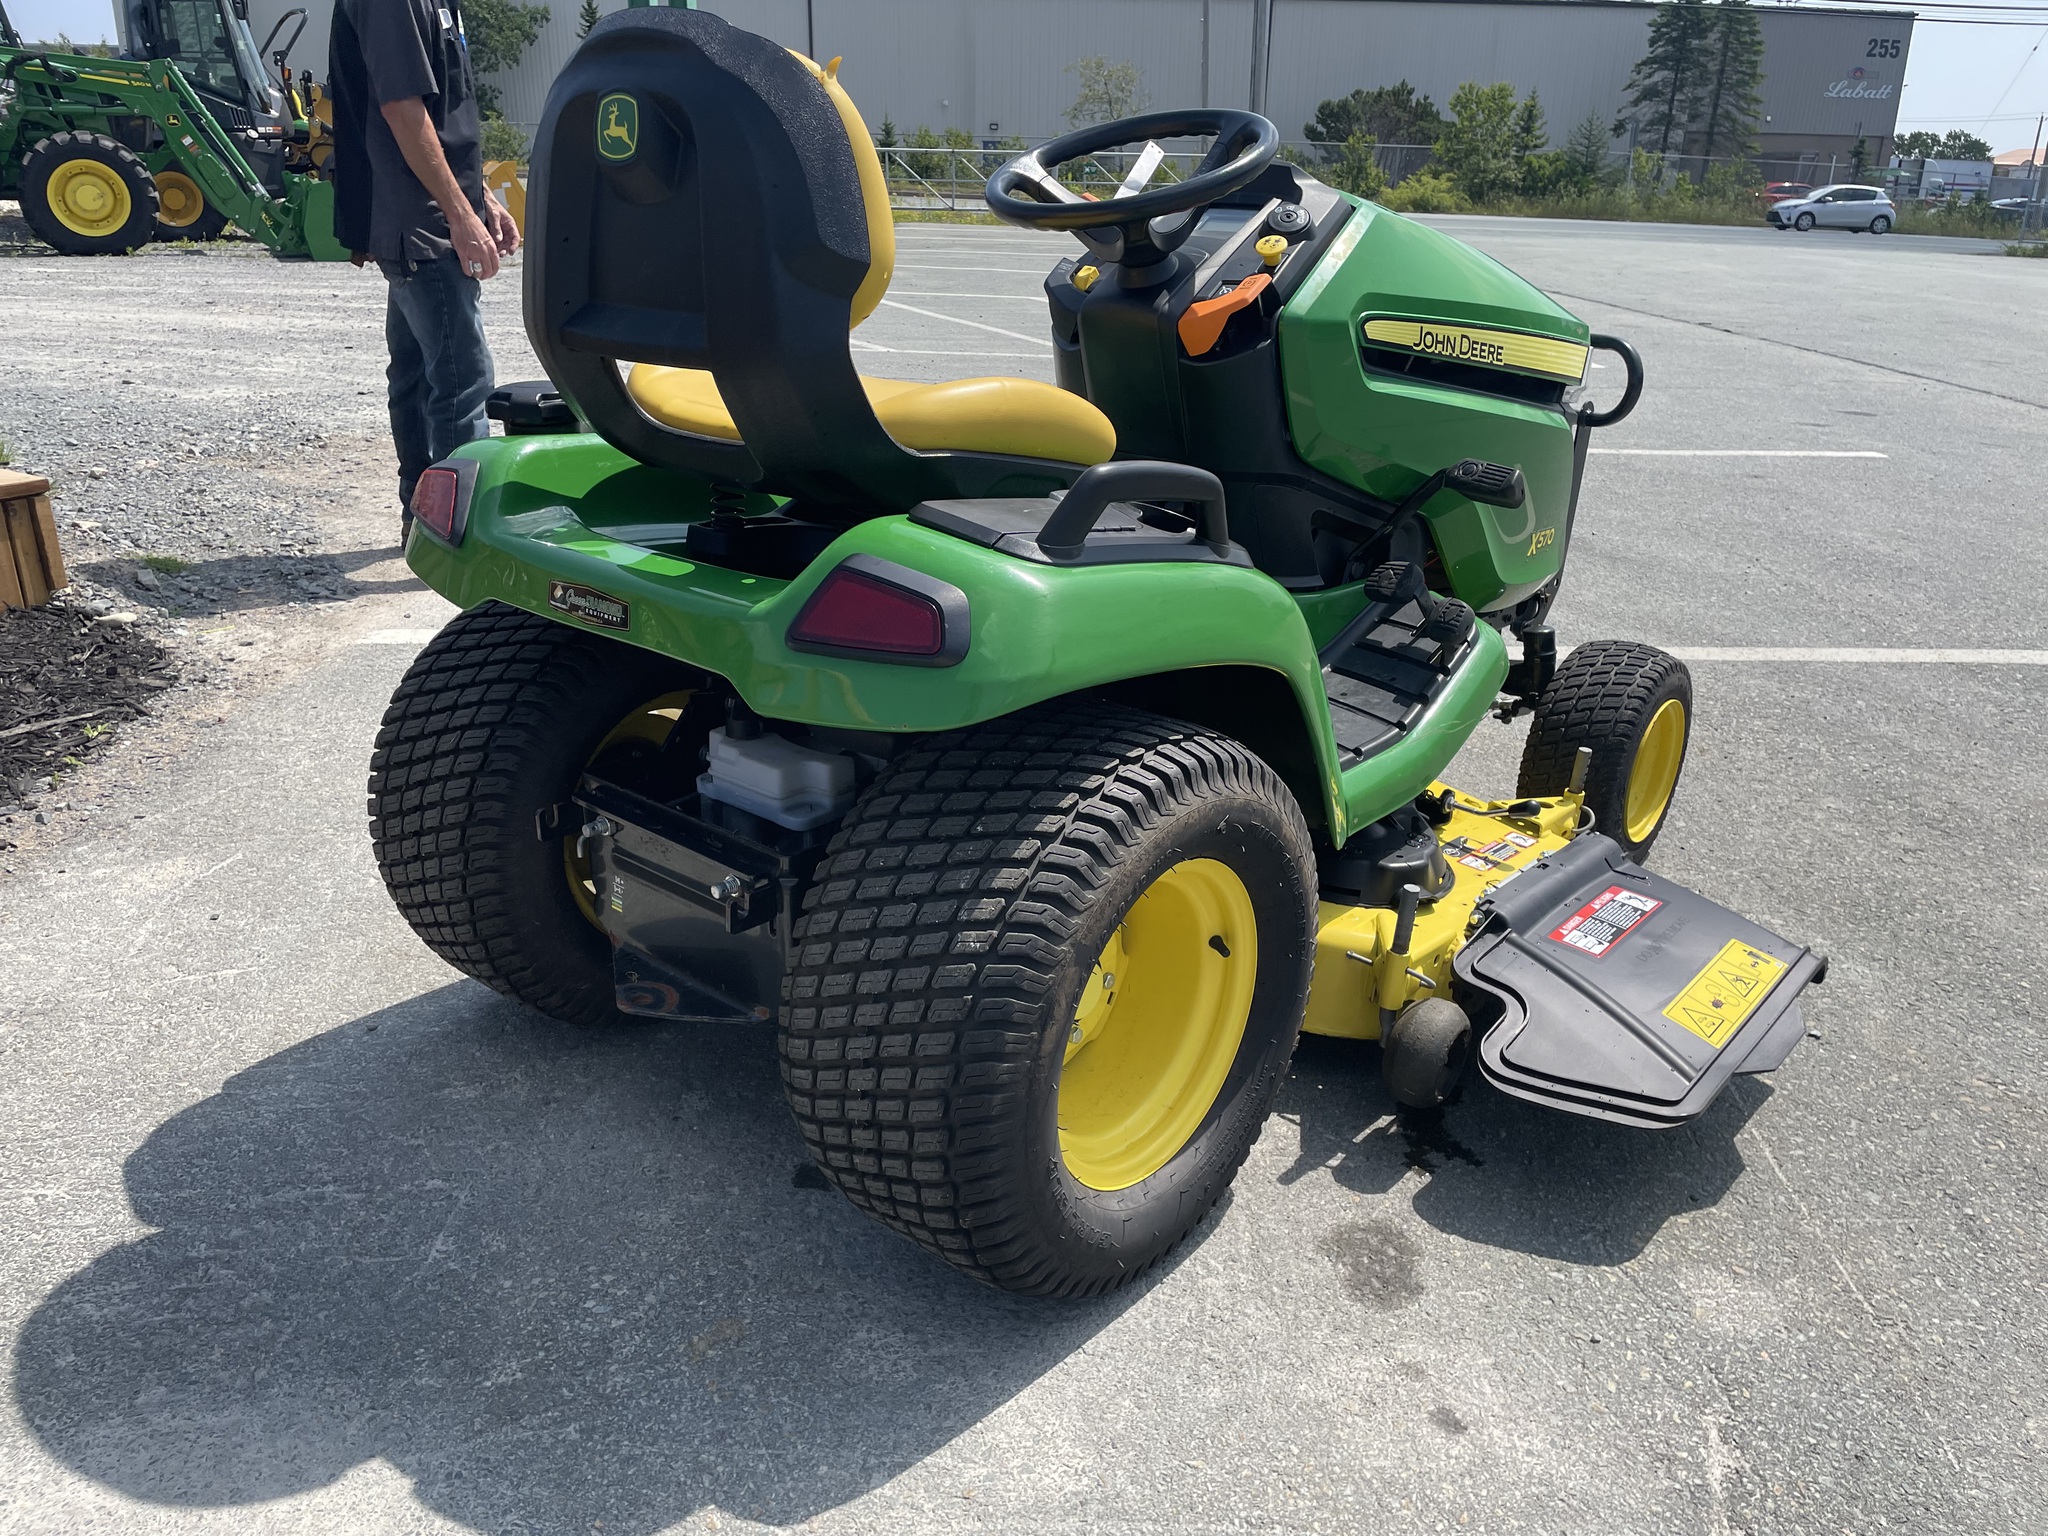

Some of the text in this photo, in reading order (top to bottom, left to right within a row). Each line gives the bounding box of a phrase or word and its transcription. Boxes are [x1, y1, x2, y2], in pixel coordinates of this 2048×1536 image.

[1866, 38, 1901, 59] 255
[1823, 80, 1893, 99] Labatt
[1412, 325, 1505, 365] JOHN DEERE
[1526, 527, 1555, 557] X570
[585, 607, 621, 623] EQUIPMENT
